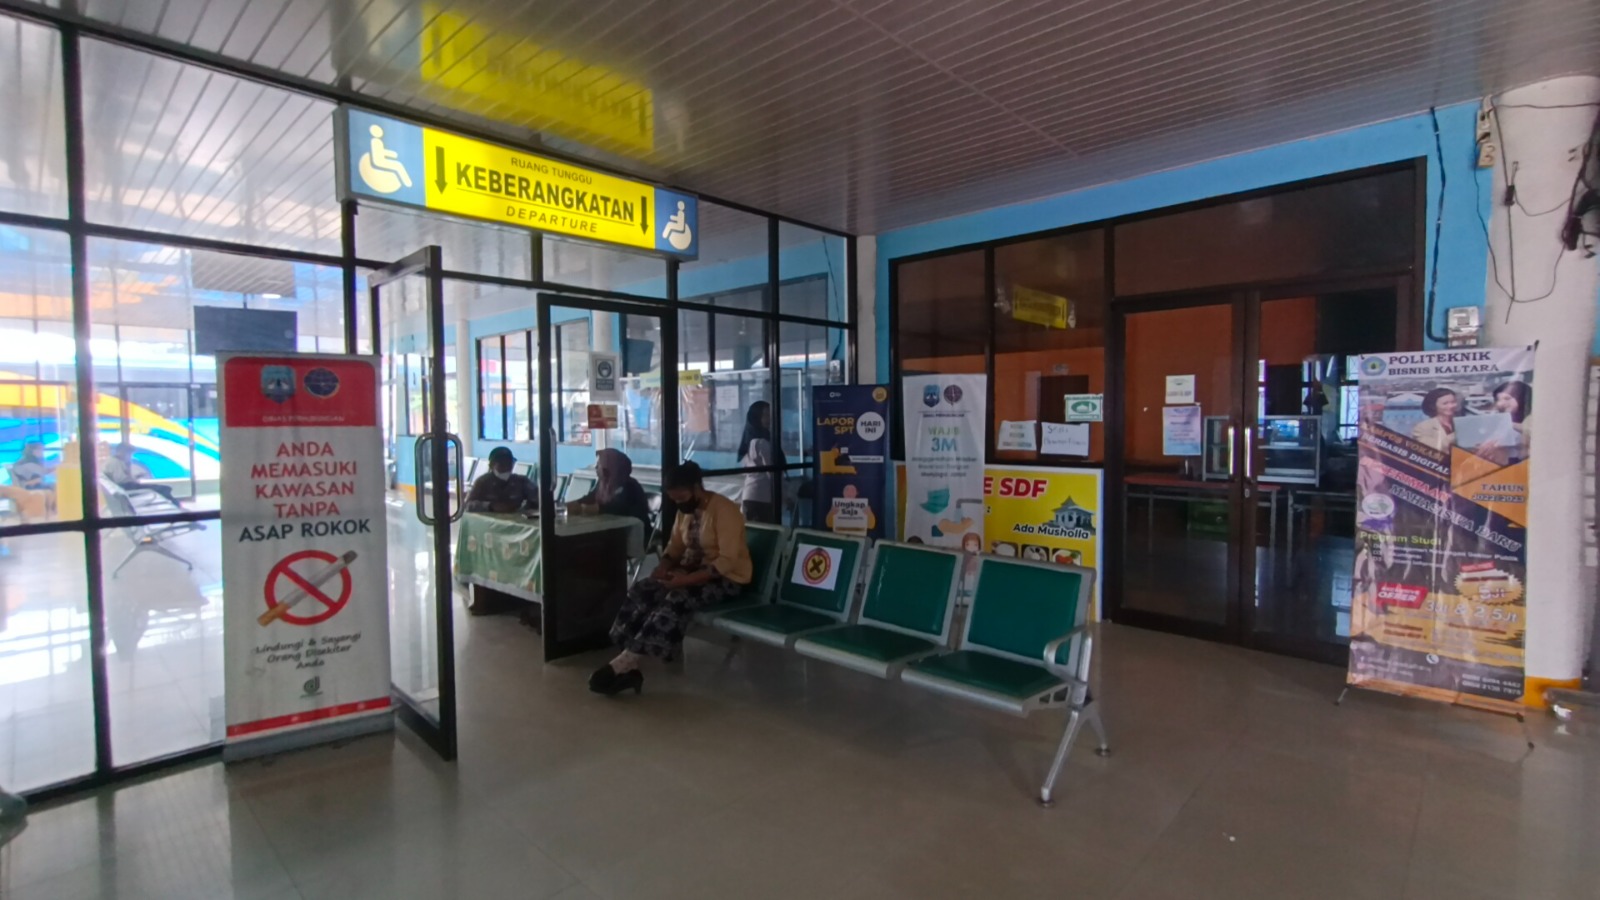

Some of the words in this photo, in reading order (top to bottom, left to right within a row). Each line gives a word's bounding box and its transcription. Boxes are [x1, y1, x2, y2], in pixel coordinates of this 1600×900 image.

[510, 157, 549, 175] RUANG
[551, 166, 593, 186] TUNGGU
[456, 161, 635, 223] KEBERANGKATAN
[506, 206, 599, 234] DEPARTURE
[1388, 351, 1491, 365] POLITEKNIK
[1388, 366, 1430, 376] BISNIS
[1435, 364, 1499, 374] KALTARA
[816, 417, 855, 426] LAPOR
[860, 420, 881, 428] HARI
[834, 426, 855, 435] SPT
[276, 442, 335, 457] ANDA
[931, 437, 957, 452] 3M
[251, 461, 358, 479] MEMASUKI
[1408, 453, 1450, 475] DIGITAL
[255, 481, 355, 499] KAWASAN
[999, 477, 1047, 498] SDF
[1481, 483, 1525, 493] TAHUN
[273, 501, 341, 519] TANPA
[834, 501, 866, 509] Ungkap
[841, 508, 858, 516] Saja
[1390, 483, 1475, 533] MAHASISWA
[239, 524, 294, 542] ASAP
[301, 518, 372, 538] ROKOK
[1012, 523, 1035, 534] Ada
[1037, 525, 1091, 540] Musholla
[1360, 531, 1408, 543] Program
[1410, 536, 1442, 546] Studi
[1475, 524, 1523, 553] BARU
[255, 639, 304, 654] Lindungi
[308, 638, 317, 646] &
[321, 631, 362, 645] Sayangi
[267, 652, 302, 664] Orang
[305, 644, 352, 658] Disekitar
[295, 658, 325, 670] Anda
